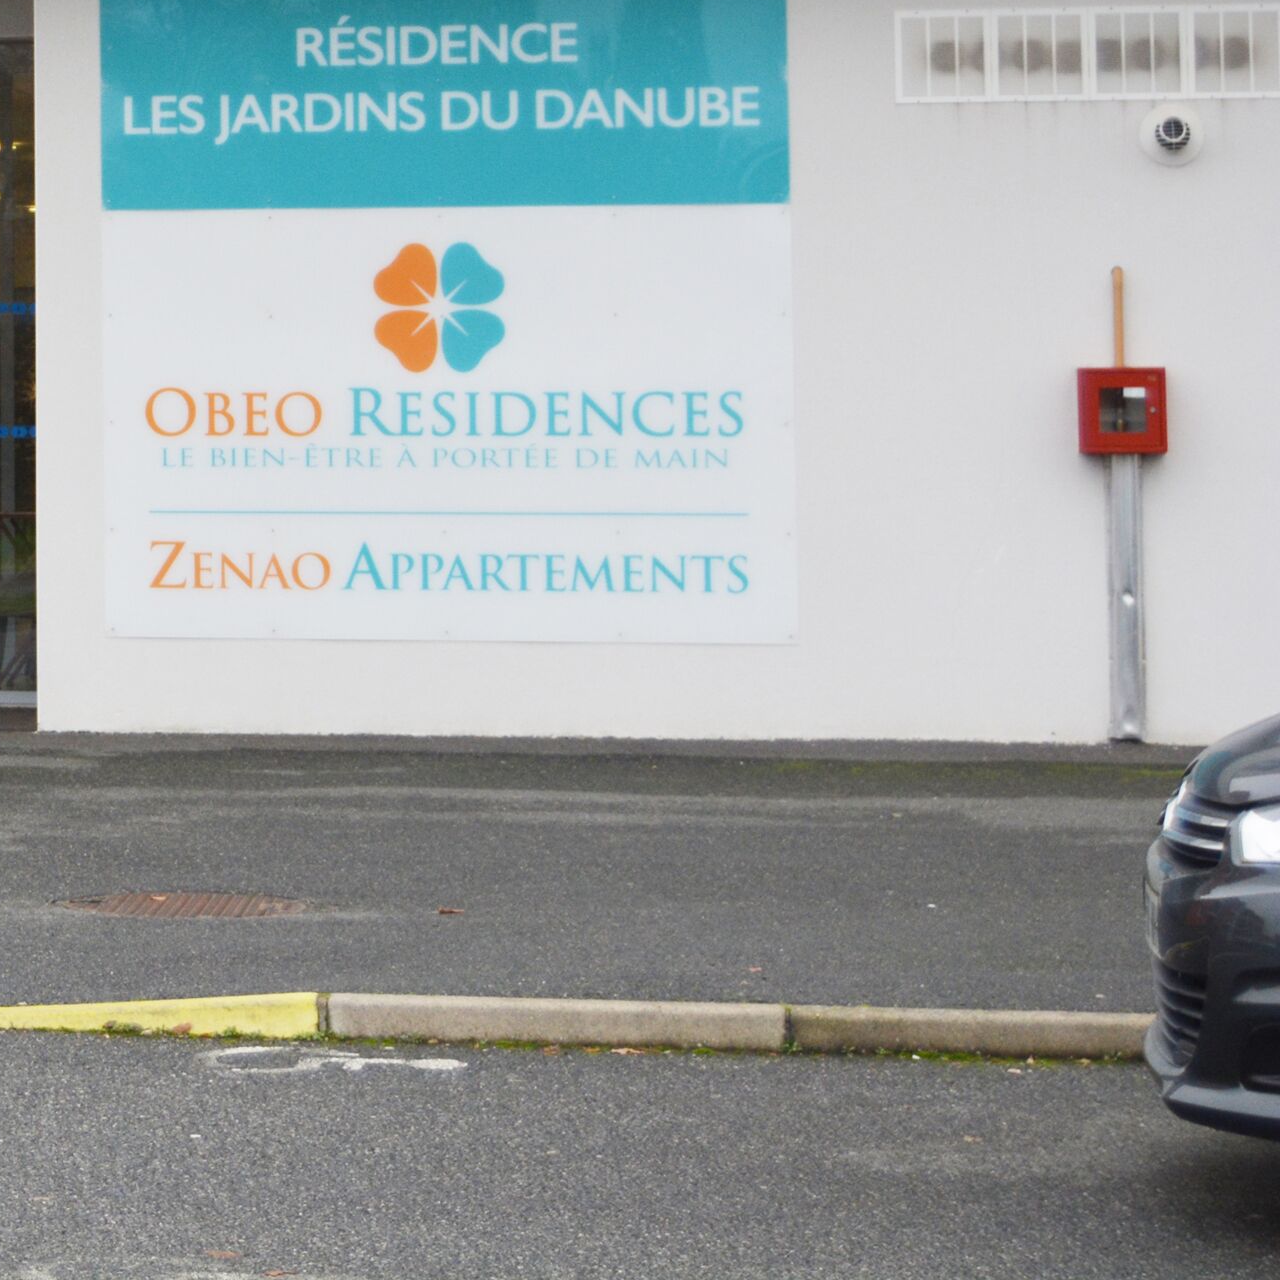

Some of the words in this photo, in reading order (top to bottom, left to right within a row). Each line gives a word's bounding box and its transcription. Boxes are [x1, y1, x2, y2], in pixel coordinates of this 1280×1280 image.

[295, 15, 579, 67] RÉSIDENCE
[122, 94, 206, 136] LES
[214, 91, 427, 145] JARDINS
[440, 90, 519, 131] DU
[534, 86, 761, 130] DANUBE
[144, 386, 324, 438] OBEO
[349, 386, 745, 438] RESIDENCES
[160, 446, 194, 470] LE
[208, 441, 384, 470] BIEN-ÊTRE
[395, 440, 418, 470] À
[431, 441, 559, 470] PORTÉE
[575, 445, 618, 471] DE
[632, 445, 730, 471] MAIN
[148, 540, 332, 591] ZENAO
[343, 542, 751, 595] APPARTEMENTS
